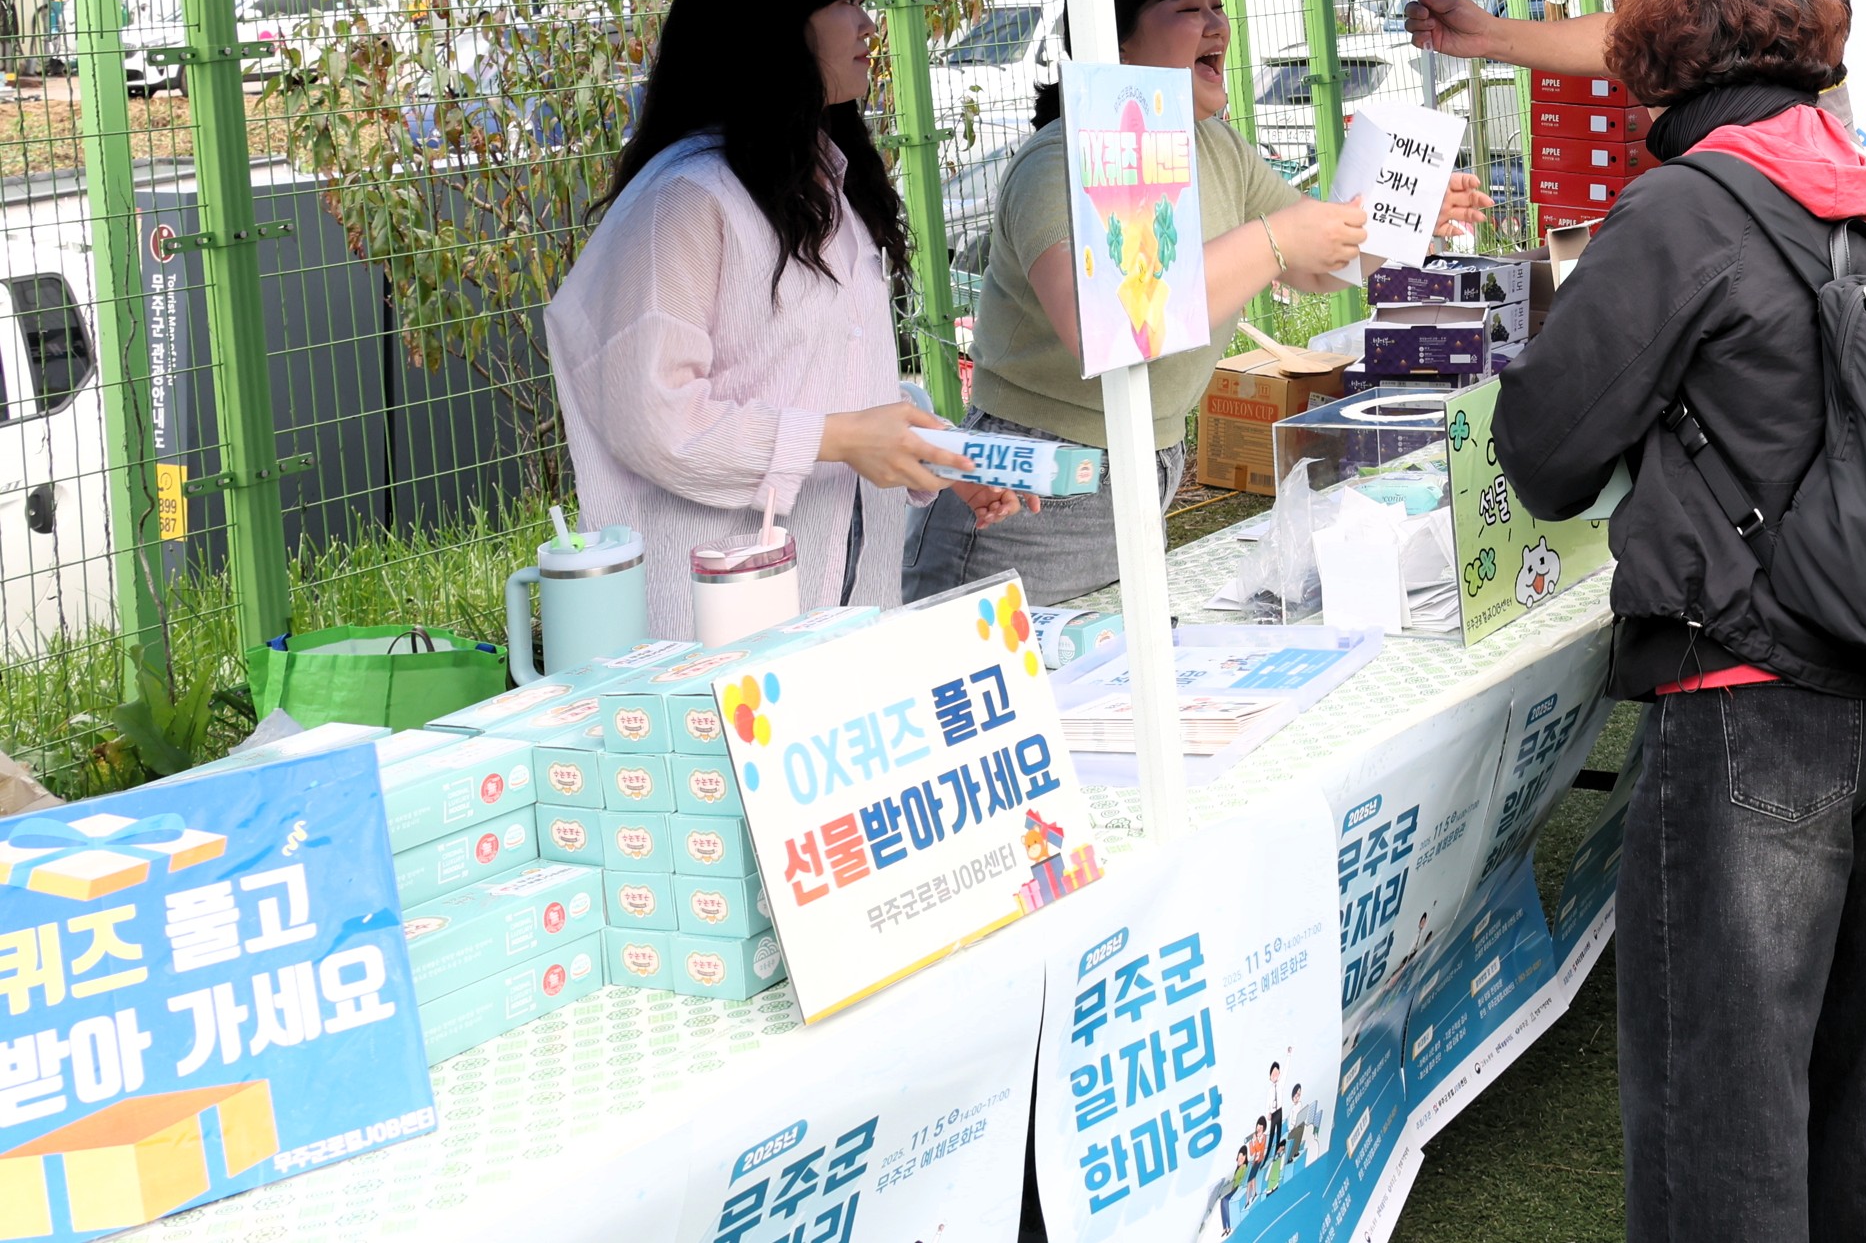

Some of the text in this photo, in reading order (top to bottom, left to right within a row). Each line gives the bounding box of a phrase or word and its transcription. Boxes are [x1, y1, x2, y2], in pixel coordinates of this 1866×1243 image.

[1540, 113, 1560, 123] APPLE
[1541, 78, 1561, 88] APPLE
[1141, 130, 1191, 185] 이벤트
[1540, 181, 1559, 191] APPLE
[1541, 147, 1561, 157] APPLE
[1373, 202, 1423, 233] 않는다.
[1558, 217, 1577, 228] APPLE
[151, 274, 166, 448] 무주군 관광안내소
[1211, 397, 1275, 421] SEOYEON CUP
[1479, 474, 1512, 527] 선물
[783, 664, 1016, 805] OX퀴즈 풀고
[1513, 703, 1582, 779] 무주군
[1530, 697, 1555, 721] 2025년
[784, 733, 1061, 908] 선물받아가세요
[1348, 798, 1377, 827] 2025년
[1338, 804, 1420, 893] 무주군
[866, 842, 1018, 935] 무주군로컬JOB센터
[0, 903, 149, 1016] 퀴즈
[165, 863, 317, 974] 풀고
[1084, 930, 1125, 971] 2025년
[1342, 927, 1395, 1010] 마당
[1071, 932, 1207, 1047] 무주군
[1225, 949, 1309, 1013] 무주군 예체문화관
[0, 944, 396, 1129] 받아 가세요
[1069, 1007, 1216, 1133] 일자리
[711, 1115, 880, 1243] 무주군
[742, 1125, 799, 1171] 2025년
[875, 1118, 988, 1194] 무주군 예체문화관
[1079, 1085, 1223, 1215] 한마당
